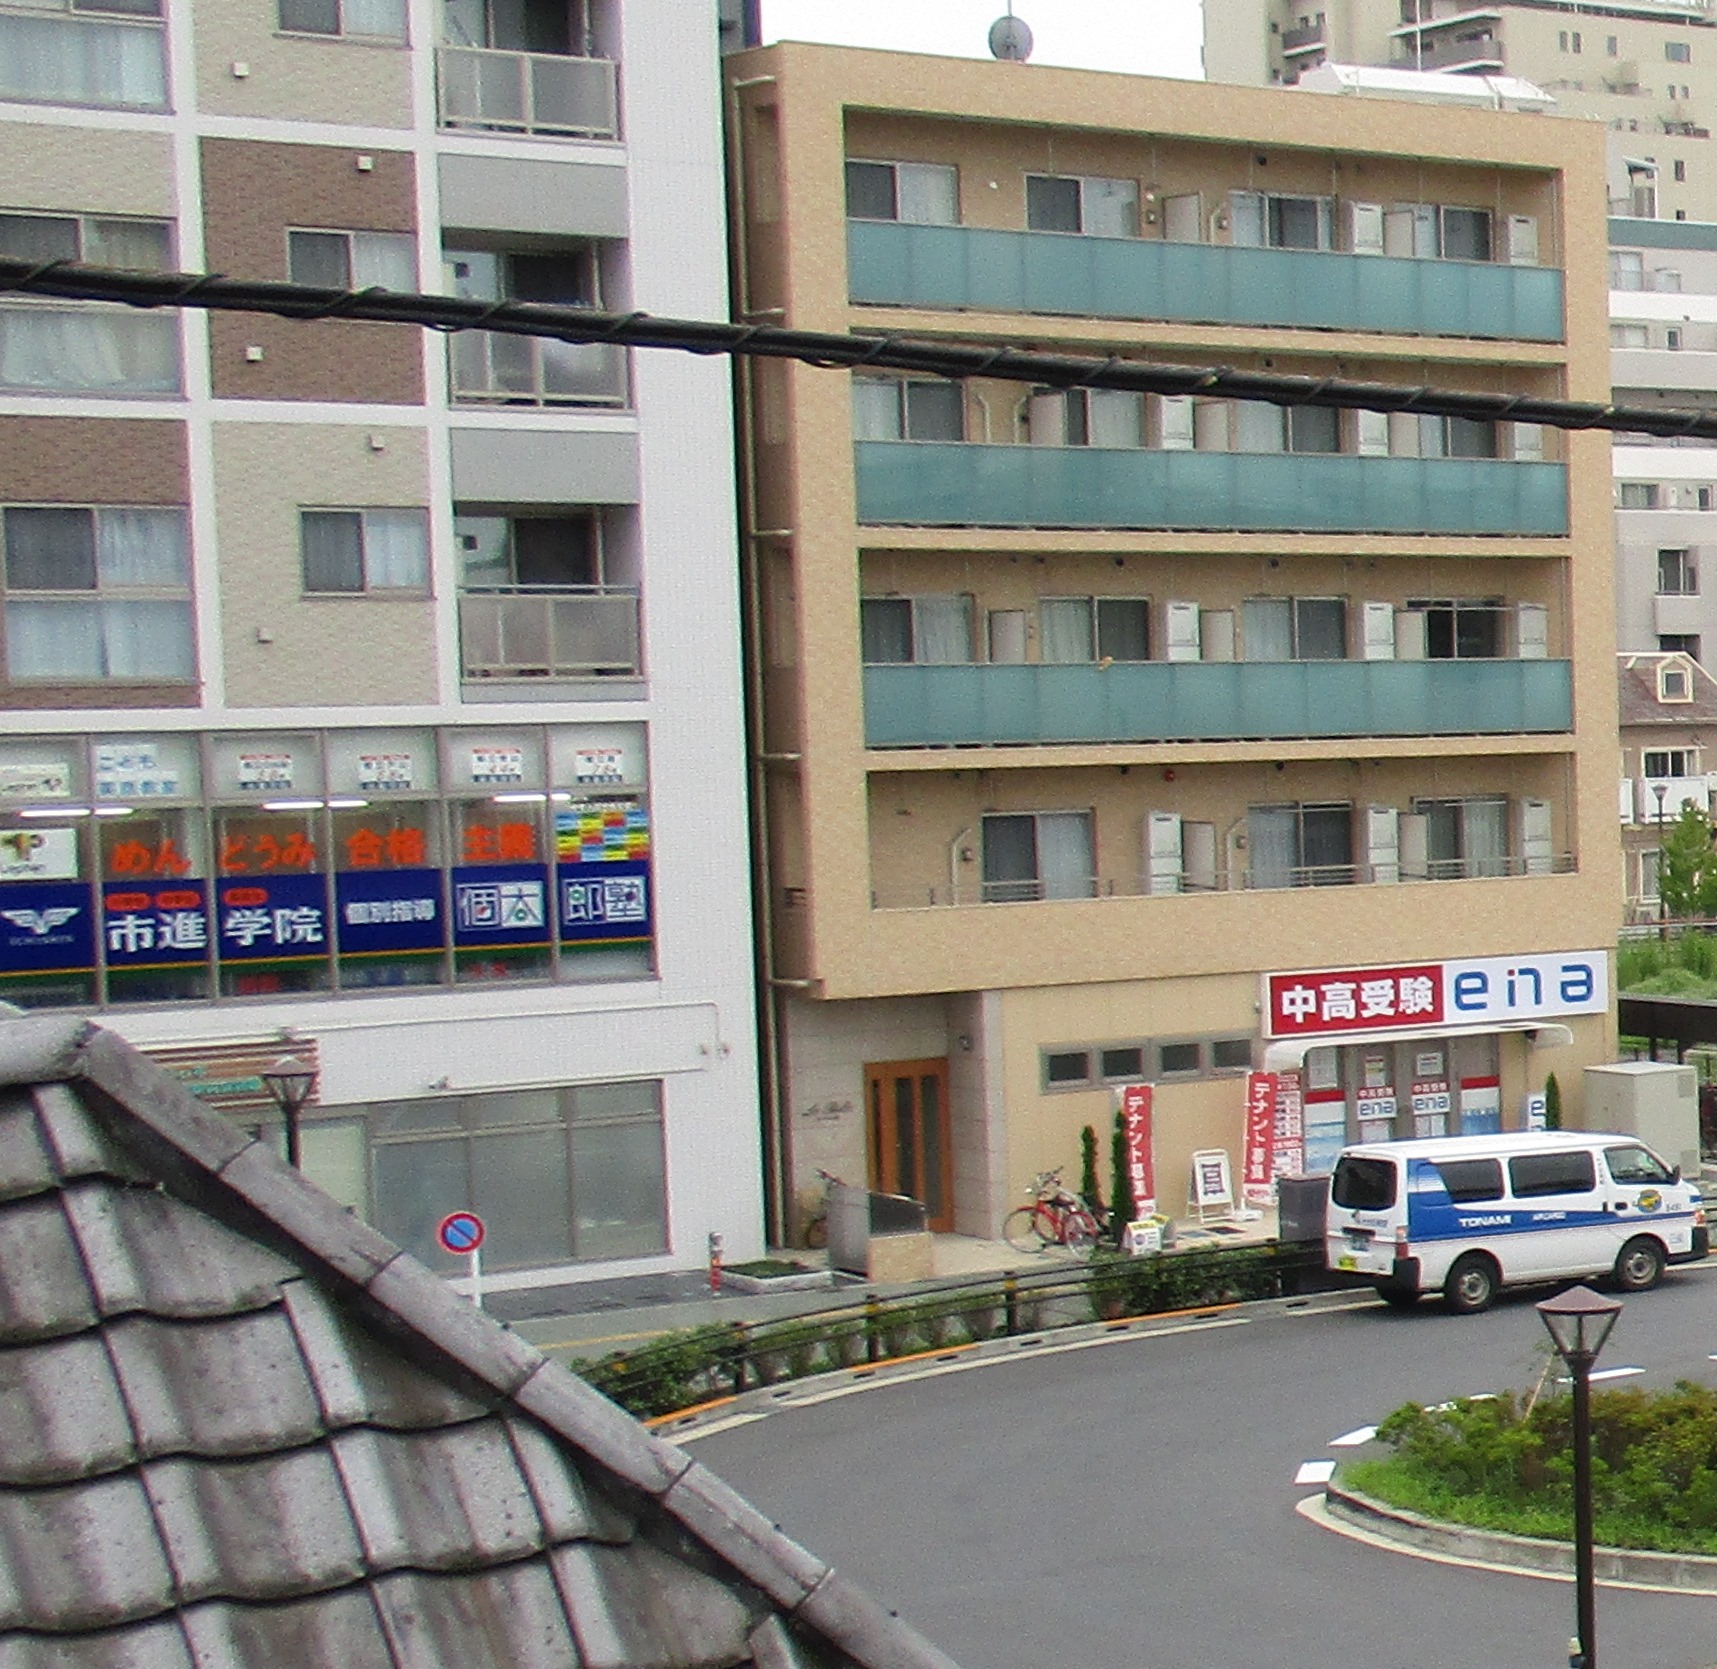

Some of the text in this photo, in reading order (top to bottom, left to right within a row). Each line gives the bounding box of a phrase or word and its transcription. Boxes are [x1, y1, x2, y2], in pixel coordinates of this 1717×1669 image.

[1455, 963, 1594, 1011] ena
[1281, 975, 1434, 1023] 中高受験
[1360, 1102, 1394, 1116] ena
[1415, 1096, 1449, 1112] ena
[1459, 1215, 1512, 1228] TONAMI
